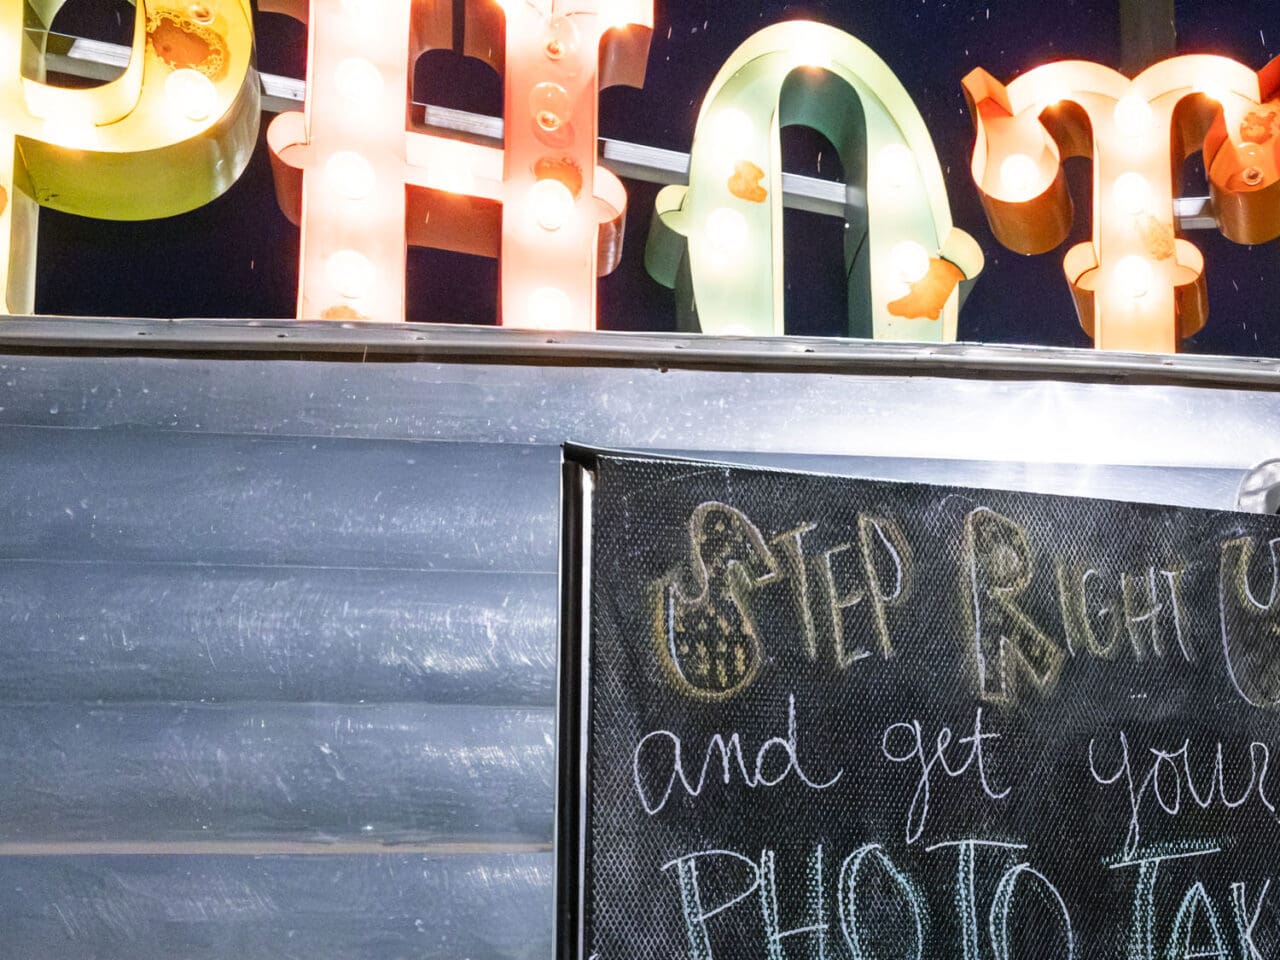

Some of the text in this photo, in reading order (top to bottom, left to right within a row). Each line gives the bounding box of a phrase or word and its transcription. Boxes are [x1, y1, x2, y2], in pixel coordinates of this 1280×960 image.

[650, 500, 913, 700] STEP
[960, 506, 1192, 704] RIGHT
[634, 693, 845, 815] and
[882, 707, 1012, 844] get
